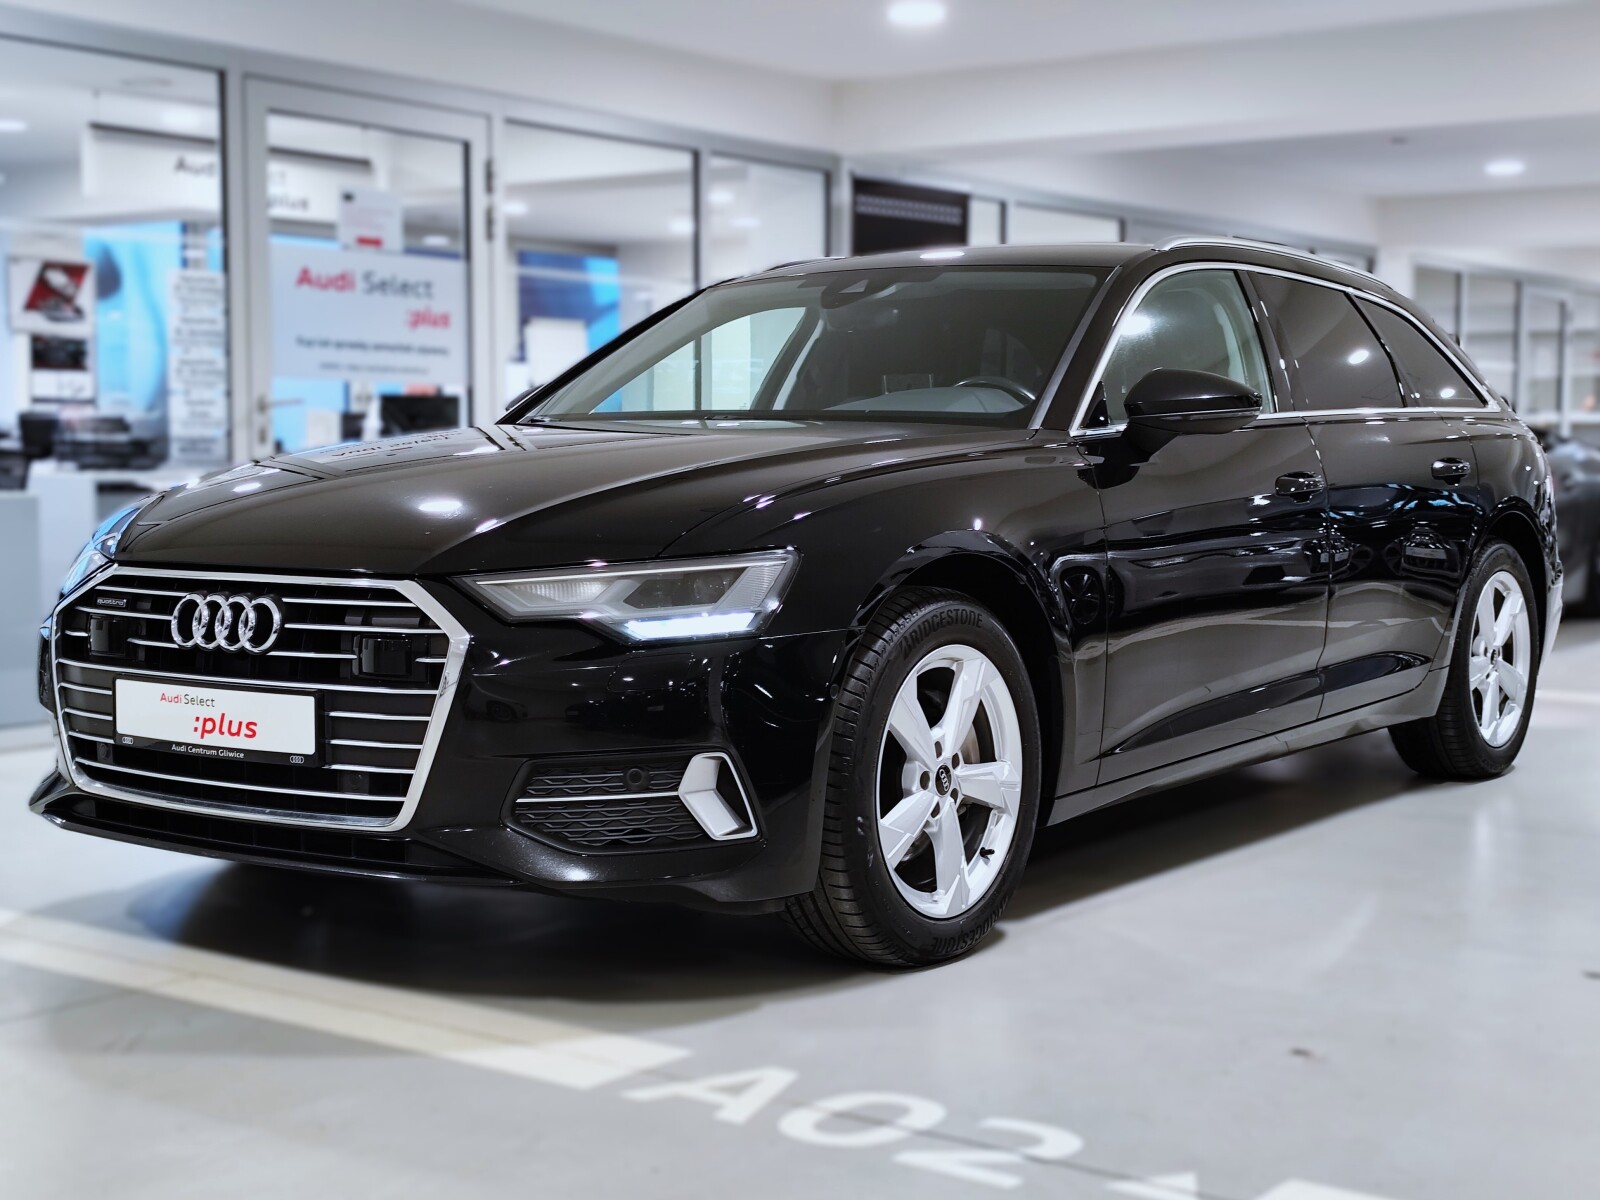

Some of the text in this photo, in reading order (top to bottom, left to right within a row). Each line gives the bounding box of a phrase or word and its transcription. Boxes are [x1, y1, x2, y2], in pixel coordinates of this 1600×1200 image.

[296, 266, 434, 299] Audi Select
[899, 608, 983, 659] BRIDGESTONE
[160, 692, 215, 707] Audi Select
[193, 713, 258, 739] :plus
[171, 743, 245, 759] Audi Centrum Gliwice
